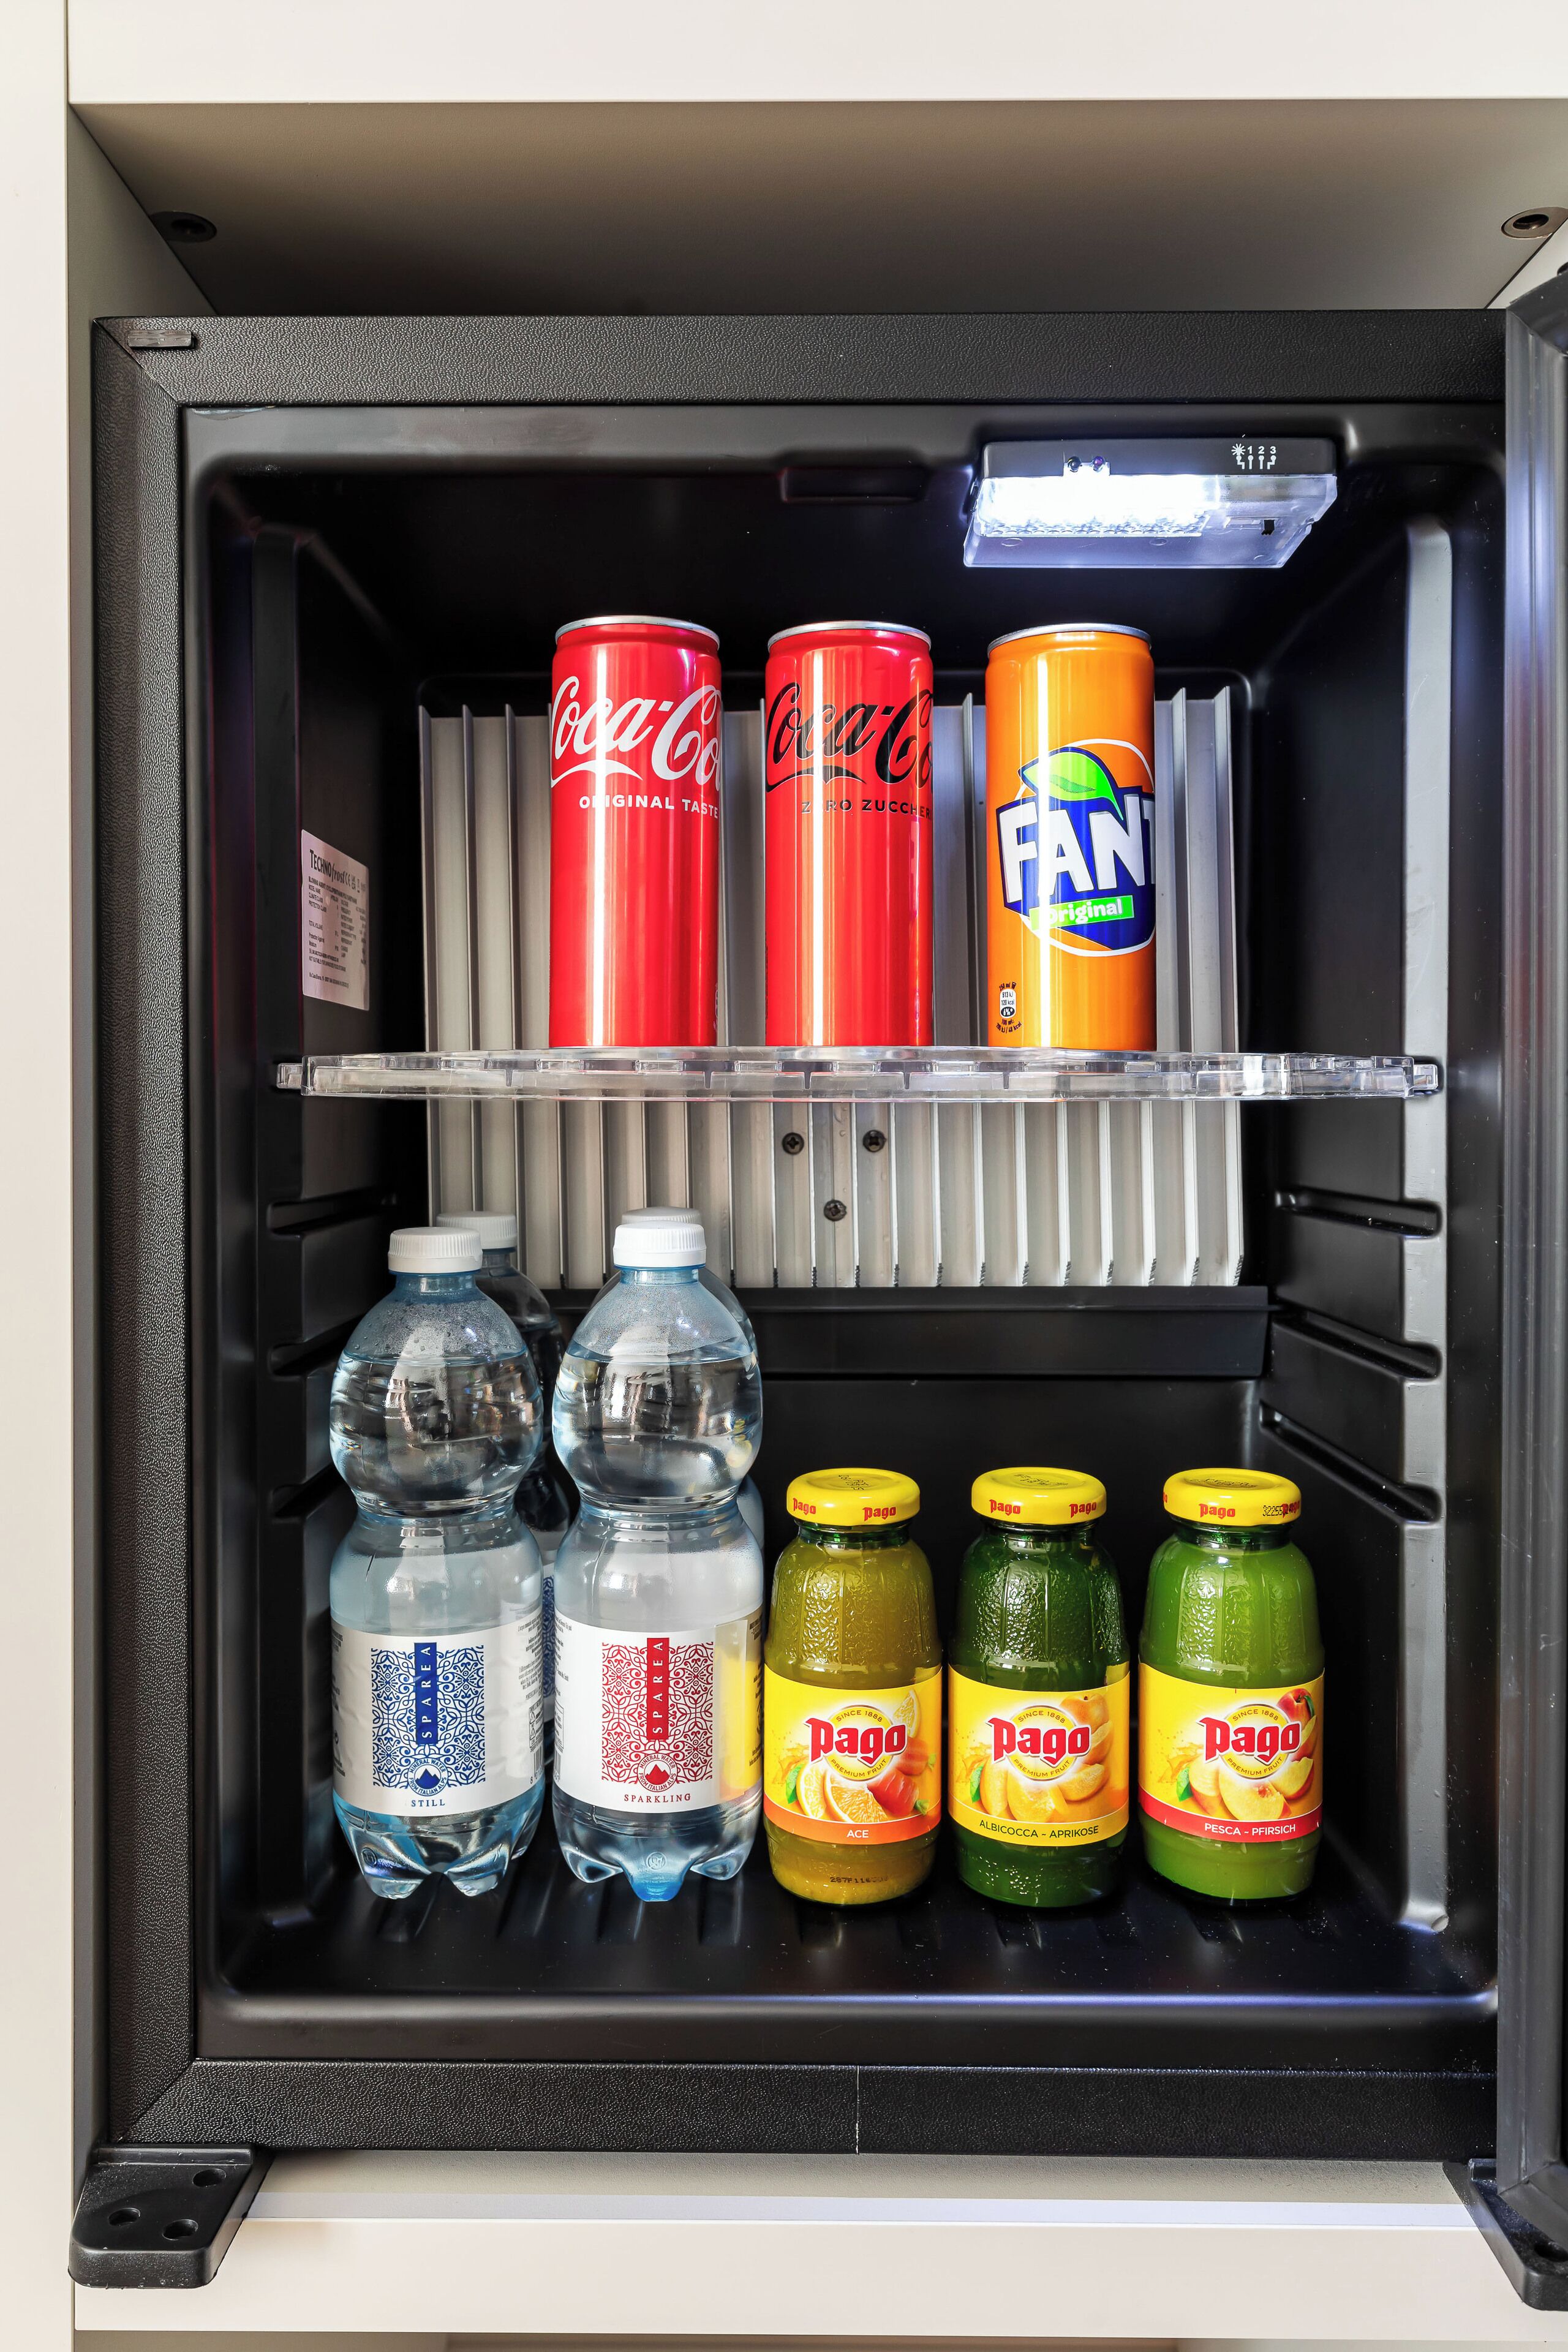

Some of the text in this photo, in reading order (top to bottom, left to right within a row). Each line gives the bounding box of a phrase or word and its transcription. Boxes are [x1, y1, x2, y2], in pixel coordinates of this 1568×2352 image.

[1248, 445, 1276, 454] 1 2 3
[766, 683, 932, 793] Coca-Co
[682, 799, 718, 819] TASTE
[801, 799, 852, 813] ZRO
[421, 1647, 432, 1738] SPAREA
[652, 1642, 663, 1733] SPAREA
[836, 1710, 883, 1722] SINCE 1888
[1018, 1711, 1065, 1724] SINCE 1888
[1232, 1709, 1278, 1721] SINCE 1888
[409, 1759, 446, 1773] MINERAL WATER
[639, 1754, 676, 1769] MINERAL WATER
[831, 1759, 887, 1777] PREMIUM FRUIT
[1014, 1759, 1070, 1777] PREMIUM FRUIT
[1227, 1757, 1283, 1775] PREMIUM FRUIT
[409, 1777, 418, 1792] FROM
[639, 1773, 647, 1787] FROM
[668, 1773, 676, 1784] ALPS
[624, 1793, 691, 1803] SPARKLING
[846, 1830, 869, 1838] ACE
[979, 1820, 1038, 1838] ALBICOCCA
[1049, 1825, 1099, 1838] APRIKOSE
[1205, 1823, 1242, 1836] PESCA
[1252, 1823, 1295, 1836] PFIRSICH
